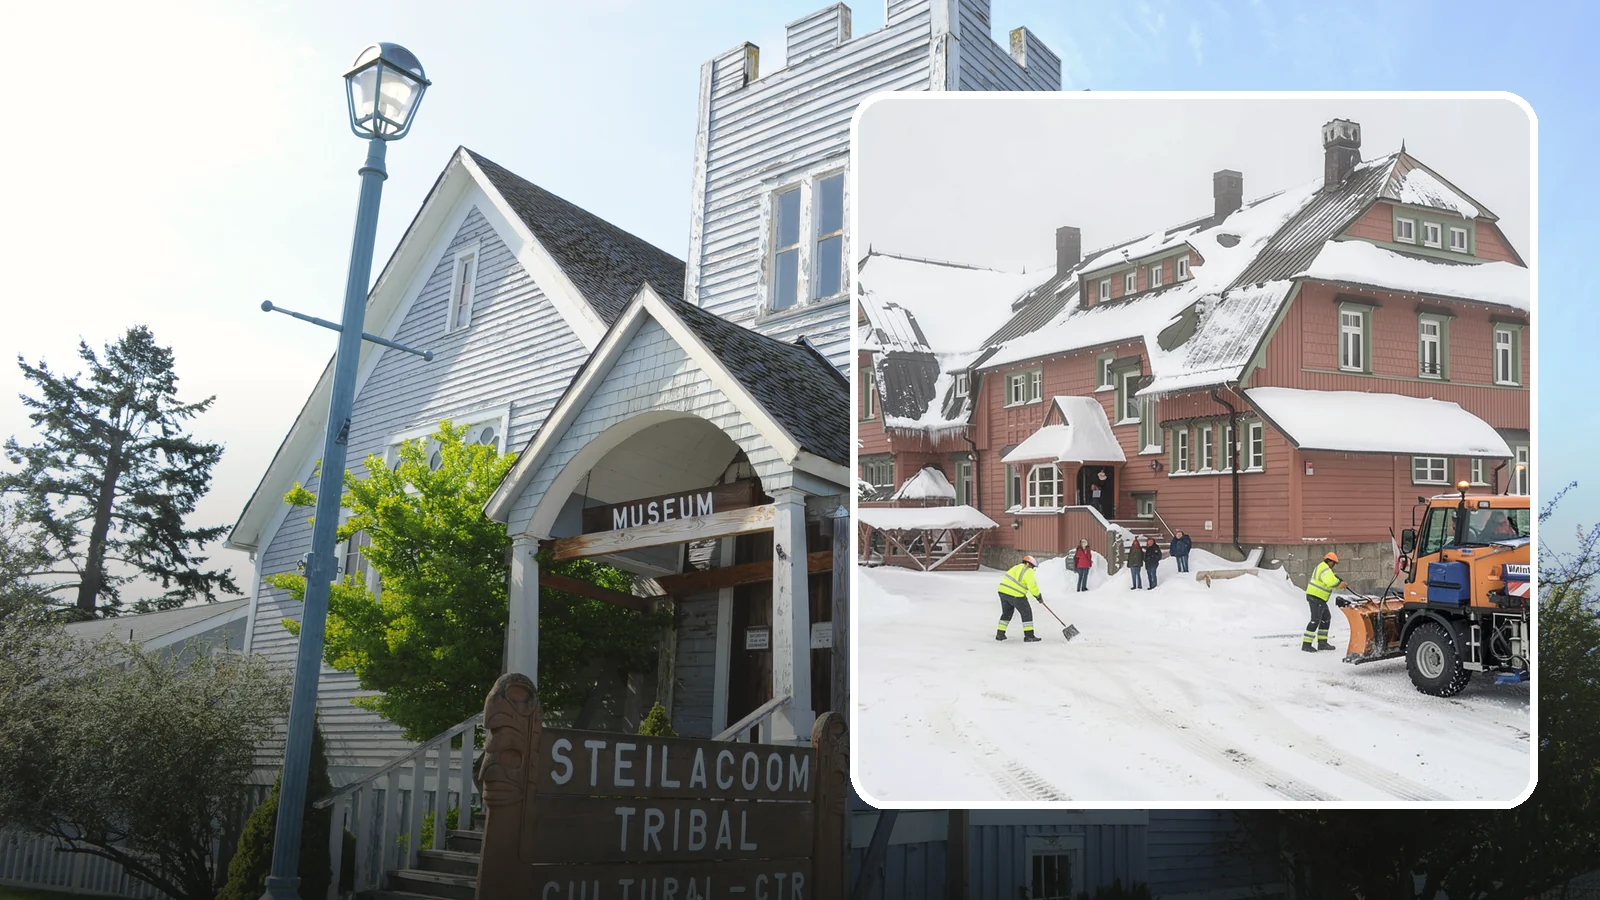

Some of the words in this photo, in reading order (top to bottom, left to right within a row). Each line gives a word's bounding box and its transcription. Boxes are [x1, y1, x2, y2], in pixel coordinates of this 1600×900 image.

[612, 491, 714, 531] MUSEUM
[550, 738, 809, 793] STEILACOOM
[615, 806, 757, 852] TRIBAL
